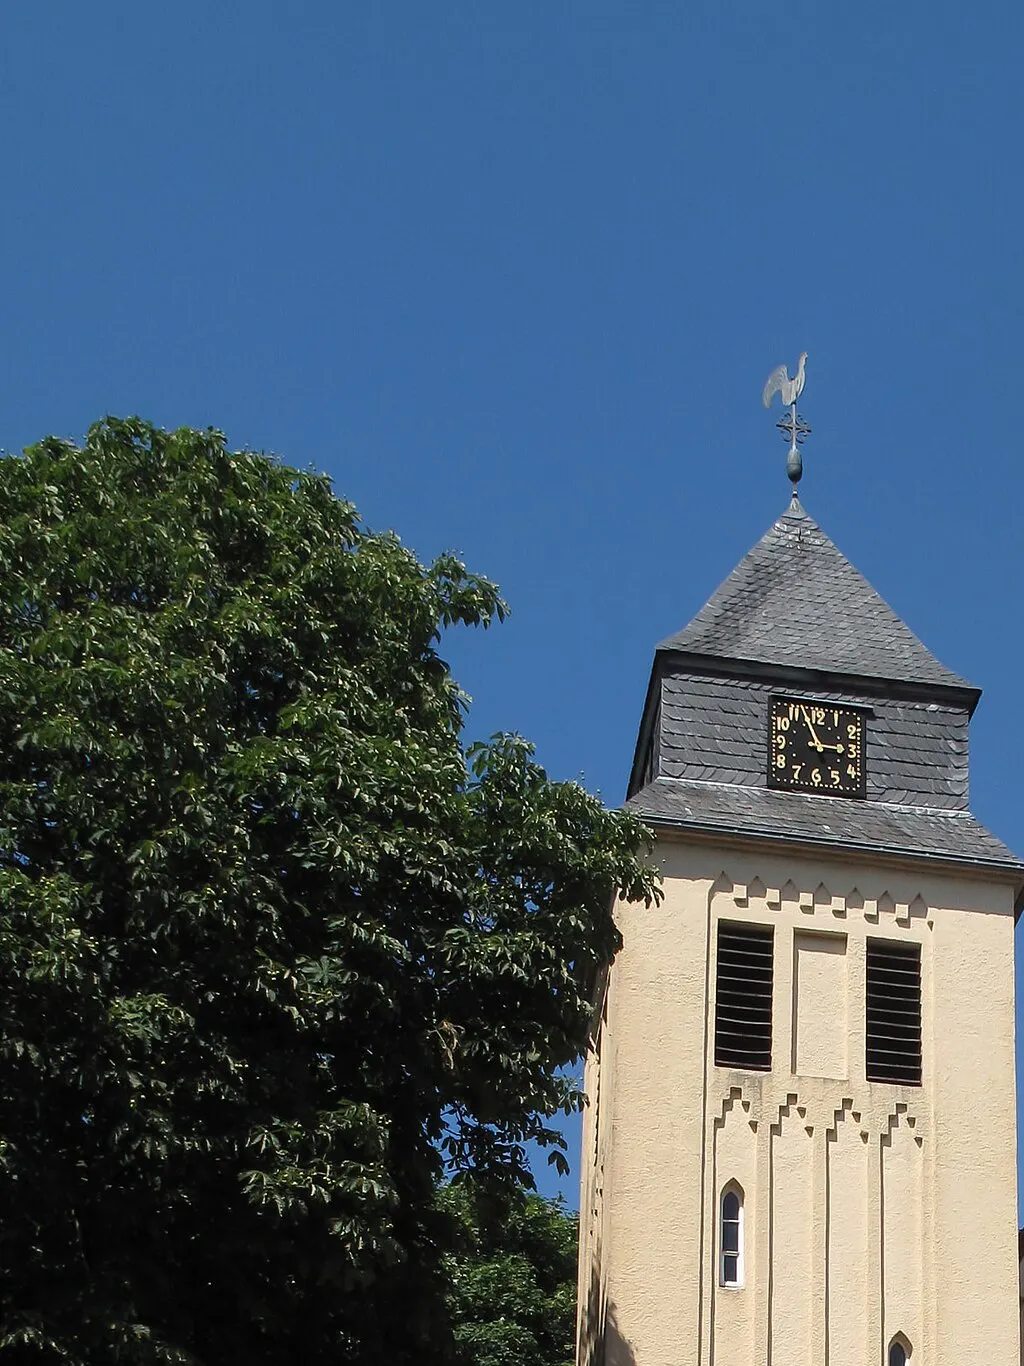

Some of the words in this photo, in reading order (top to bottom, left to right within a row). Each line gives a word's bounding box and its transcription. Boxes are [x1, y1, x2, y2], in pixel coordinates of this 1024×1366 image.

[788, 706, 800, 722] 11
[812, 709, 826, 725] 12
[834, 712, 839, 727] 1
[776, 717, 789, 730] 10
[848, 725, 856, 739] 2
[777, 736, 786, 749] 9
[848, 744, 856, 758] 3
[777, 754, 785, 768] 8
[792, 765, 802, 779] 7
[812, 768, 821, 783] 6
[831, 771, 840, 785] 5
[847, 764, 856, 778] 4
